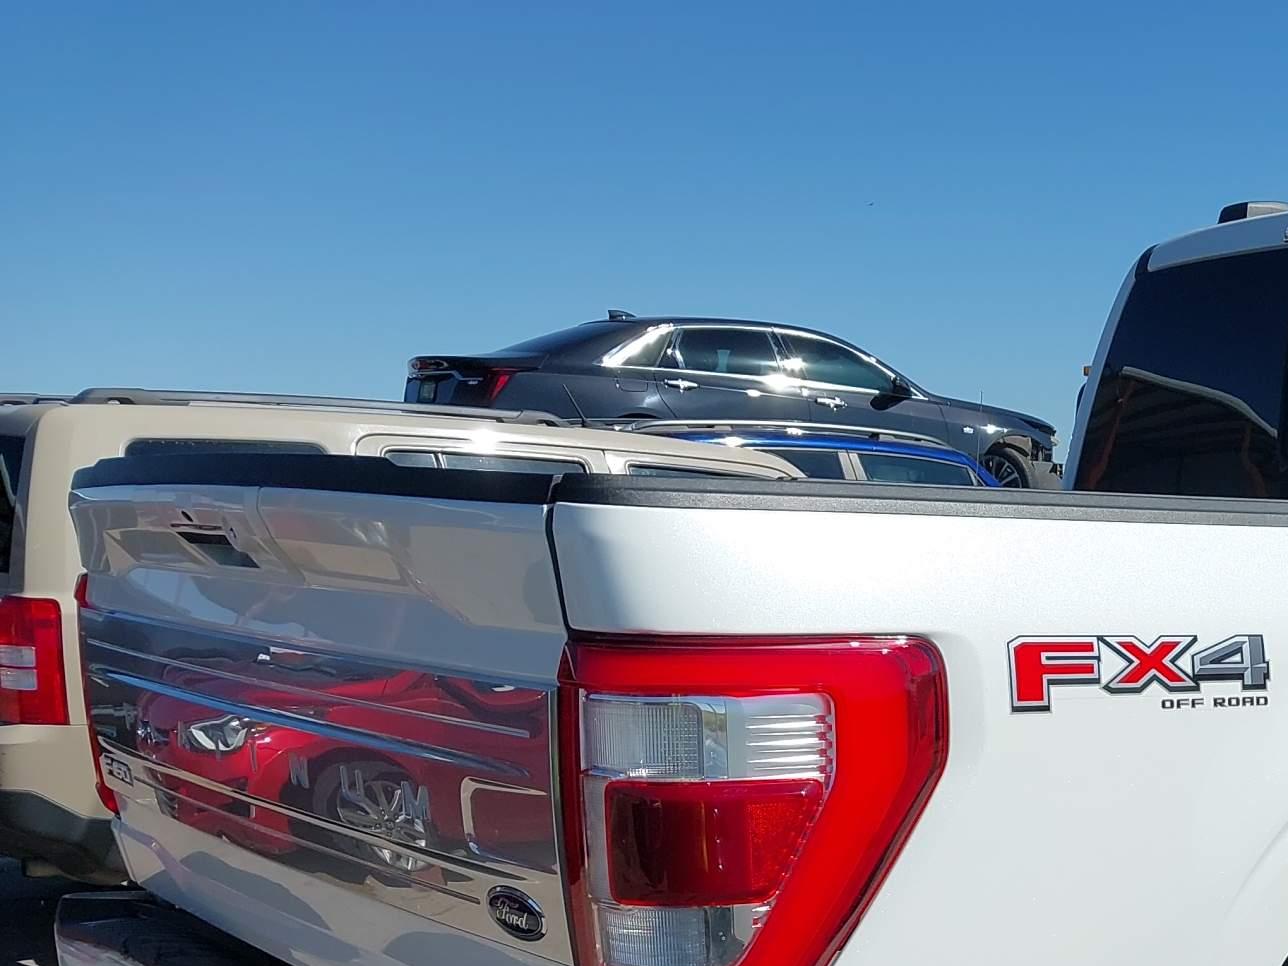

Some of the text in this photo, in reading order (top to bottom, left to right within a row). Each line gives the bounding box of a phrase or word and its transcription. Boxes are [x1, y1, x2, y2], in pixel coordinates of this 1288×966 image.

[1006, 634, 1270, 713] FX4
[1161, 696, 1269, 709] OFF ROAD
[496, 898, 529, 930] Ford
